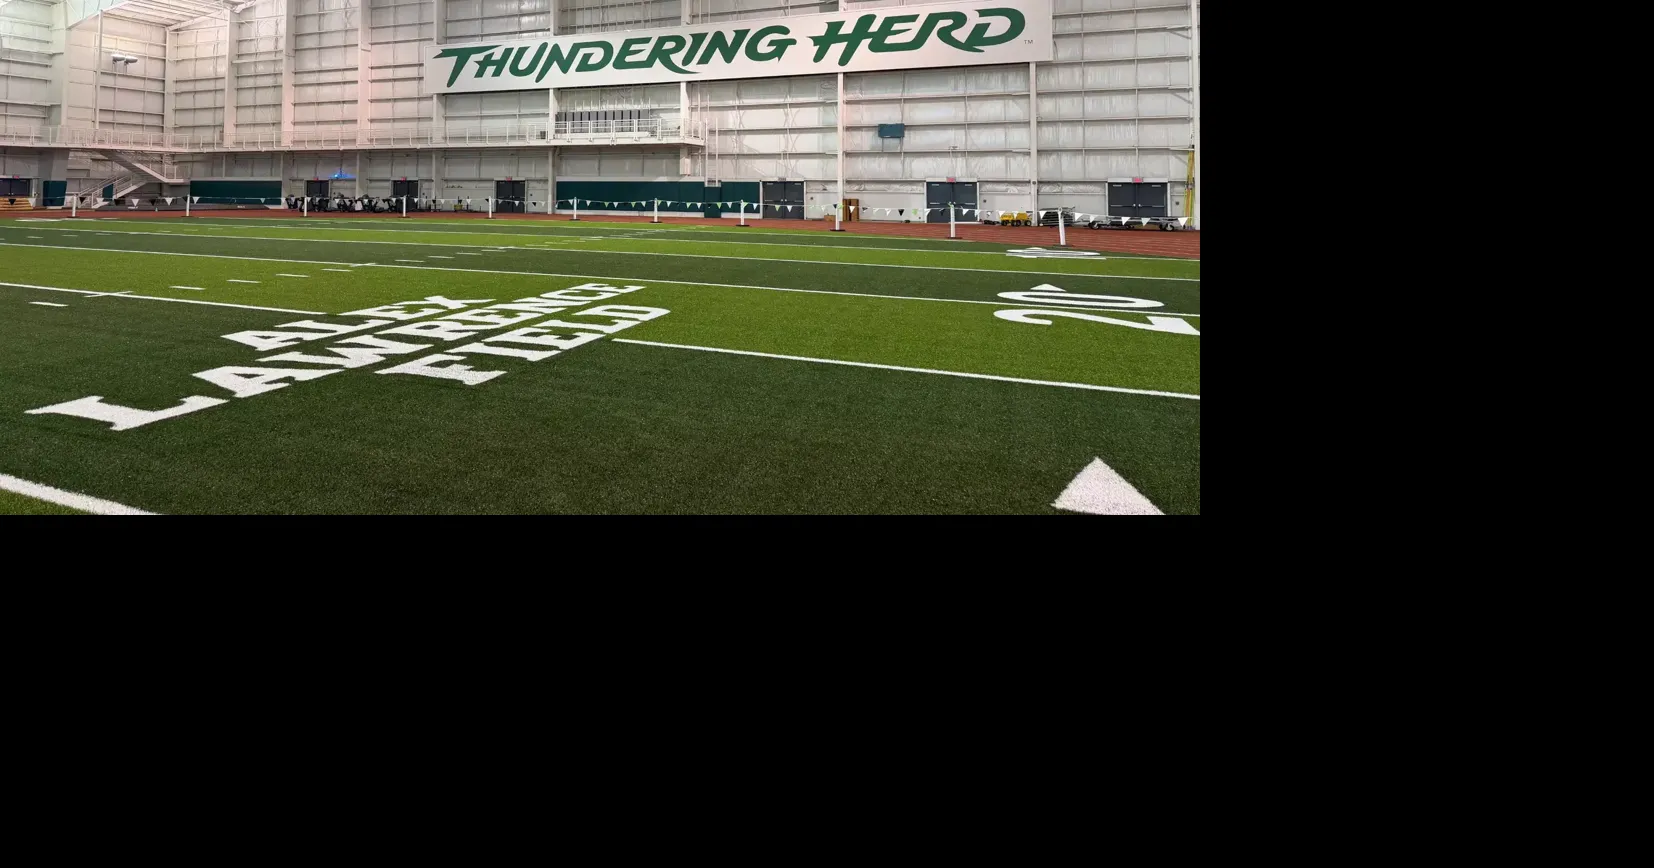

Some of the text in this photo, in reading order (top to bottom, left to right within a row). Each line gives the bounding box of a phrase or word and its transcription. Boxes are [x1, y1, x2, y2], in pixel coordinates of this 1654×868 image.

[433, 26, 797, 88] THUNDERING
[811, 7, 1026, 66] HERD
[221, 295, 498, 352] ALEX
[374, 304, 671, 386] FIELD
[993, 291, 1200, 335] 20
[24, 282, 646, 431] LAWRENCE
